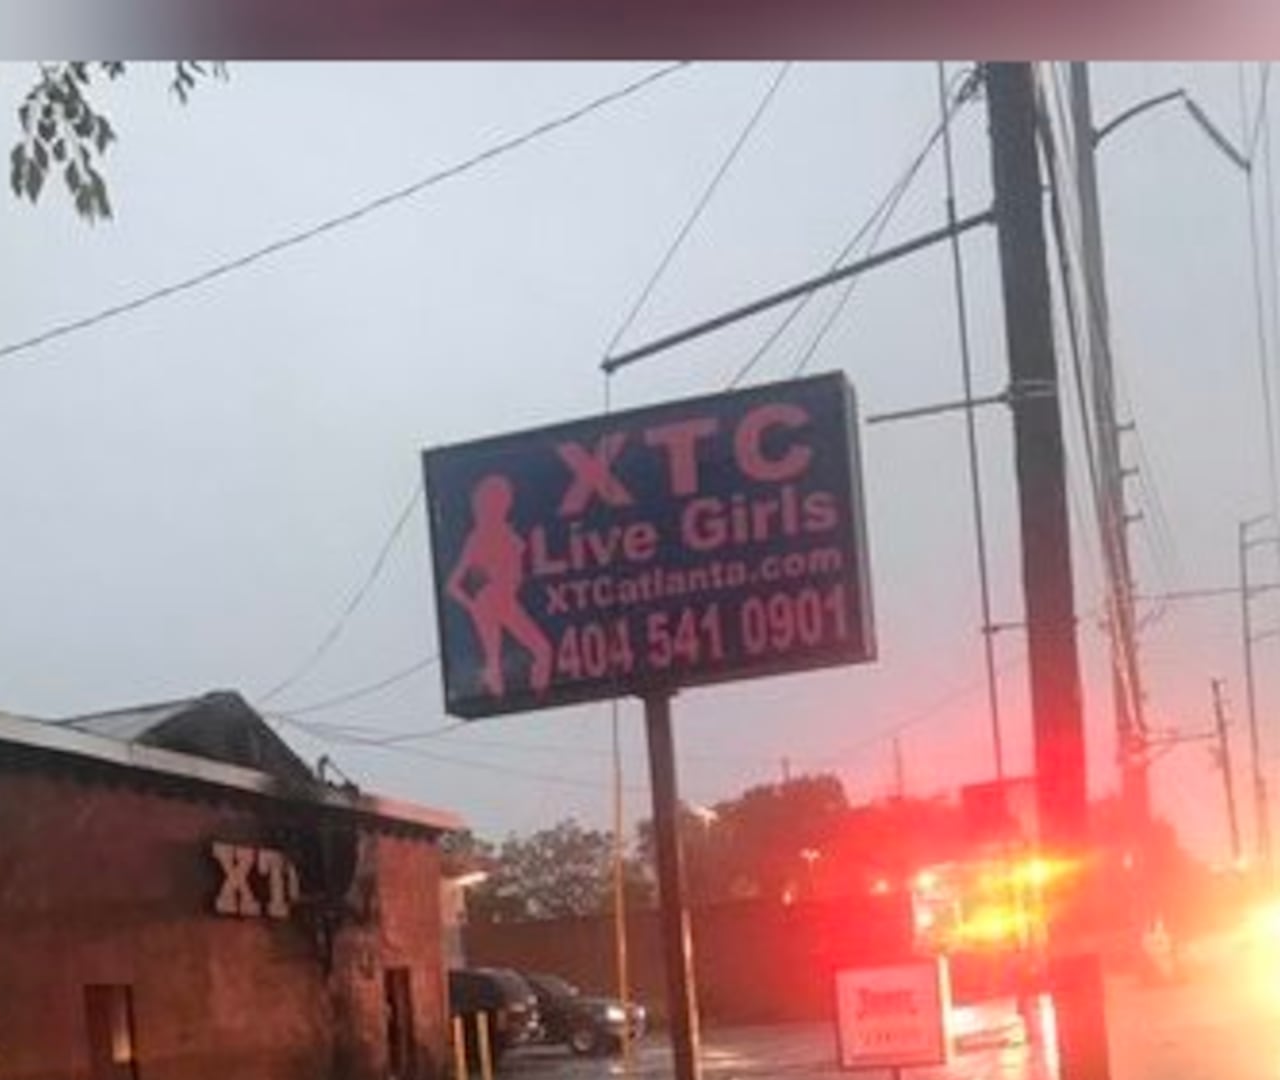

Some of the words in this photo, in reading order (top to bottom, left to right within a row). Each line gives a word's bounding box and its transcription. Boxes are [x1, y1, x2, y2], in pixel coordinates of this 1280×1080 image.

[558, 404, 812, 515] XTC
[529, 520, 659, 576] Live
[683, 487, 837, 549] Girls
[546, 548, 842, 615] XTCatlanta.com
[557, 621, 635, 679] 404
[647, 608, 725, 668] 541
[742, 583, 846, 655] 0901
